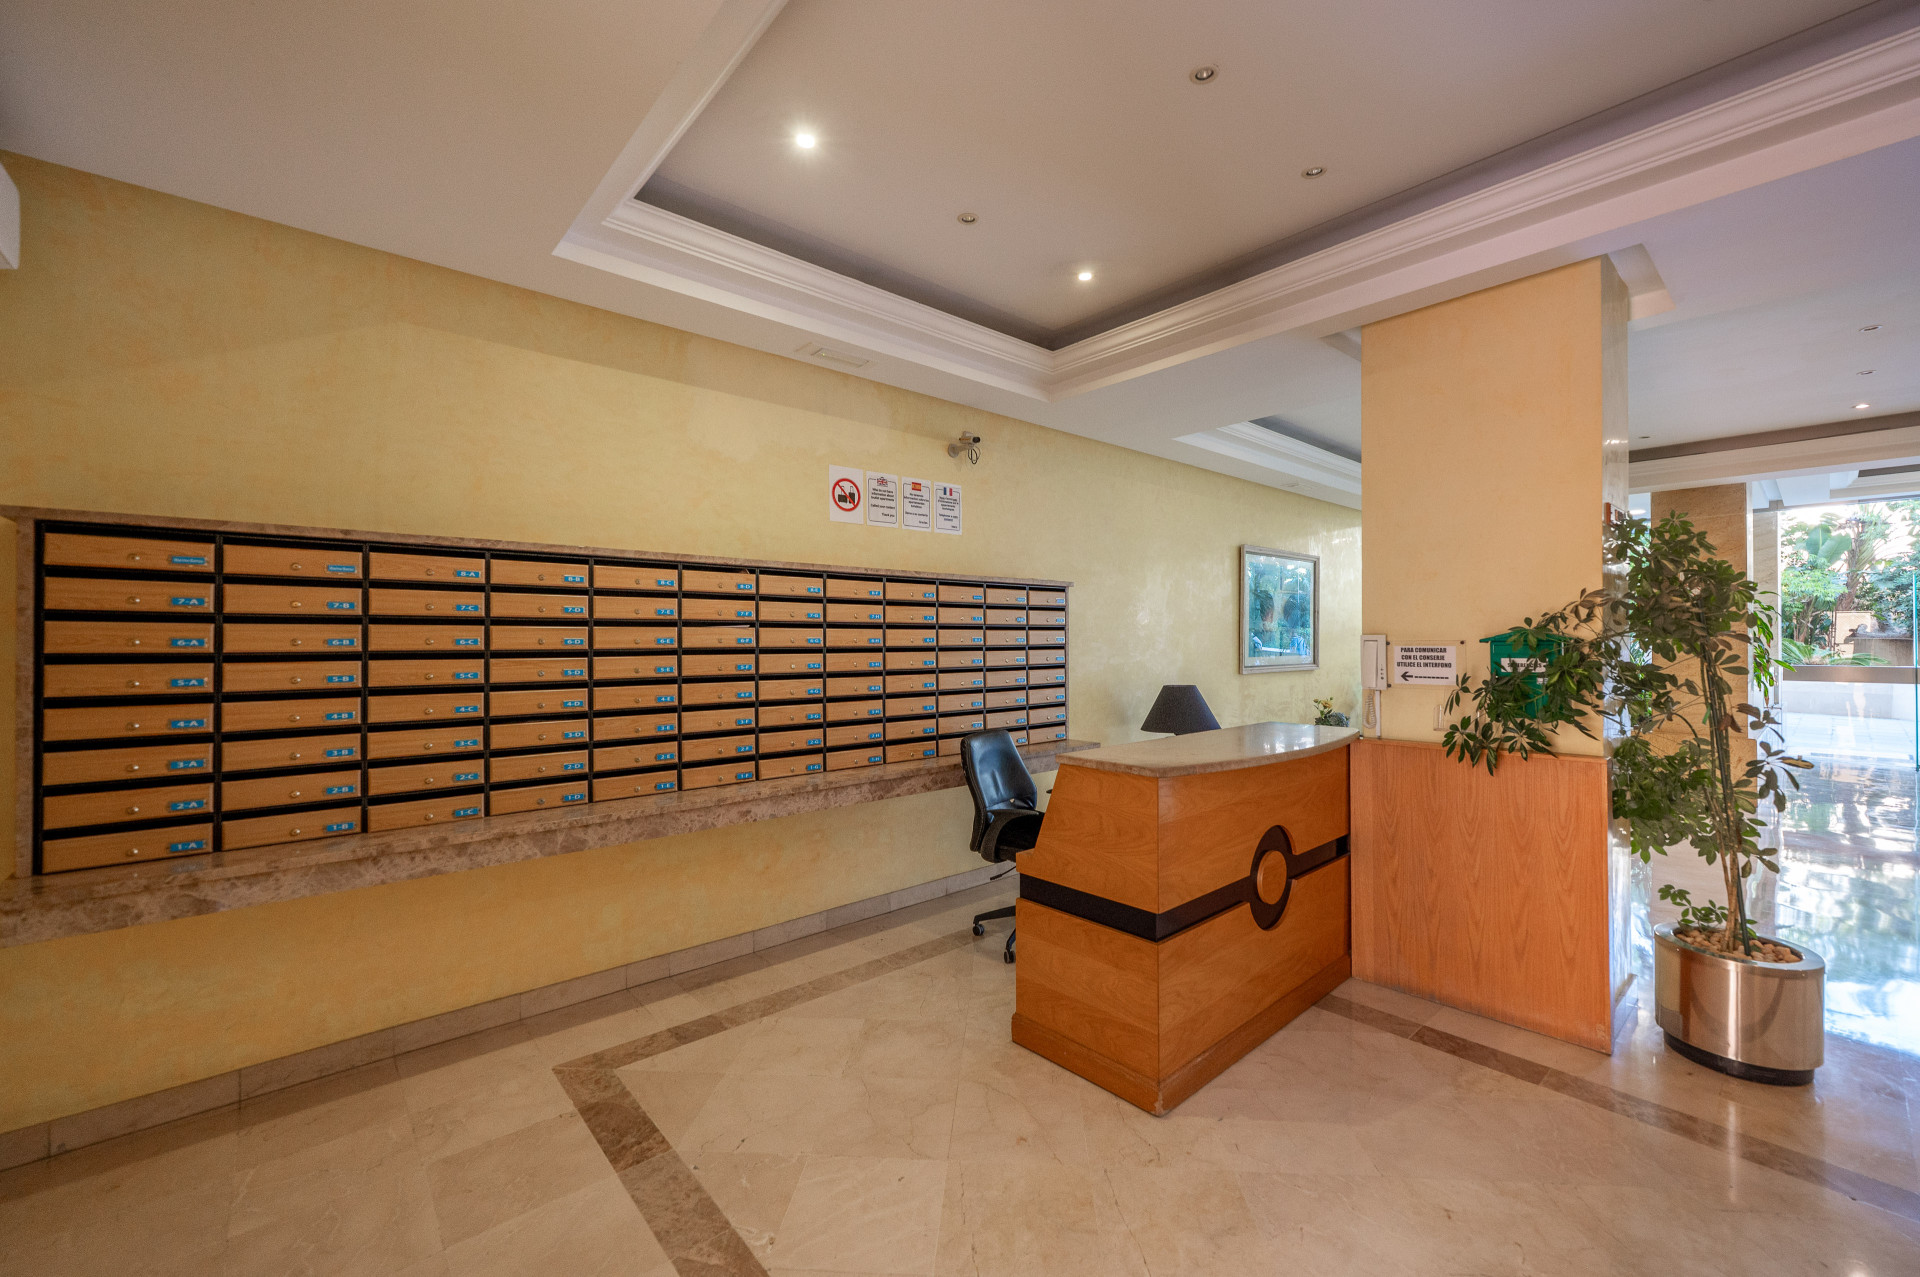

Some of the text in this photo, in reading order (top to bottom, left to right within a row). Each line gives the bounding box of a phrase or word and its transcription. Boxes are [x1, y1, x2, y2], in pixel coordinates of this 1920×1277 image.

[330, 712, 349, 720] 4-B
[176, 720, 199, 728] 4-A
[331, 749, 350, 757] 3-B
[176, 760, 198, 769] 3-A
[331, 786, 350, 794] 2-B
[176, 801, 198, 810] 2-A
[459, 808, 475, 816] 1-C
[331, 823, 350, 831] 1-B
[176, 841, 198, 851] 1-A
